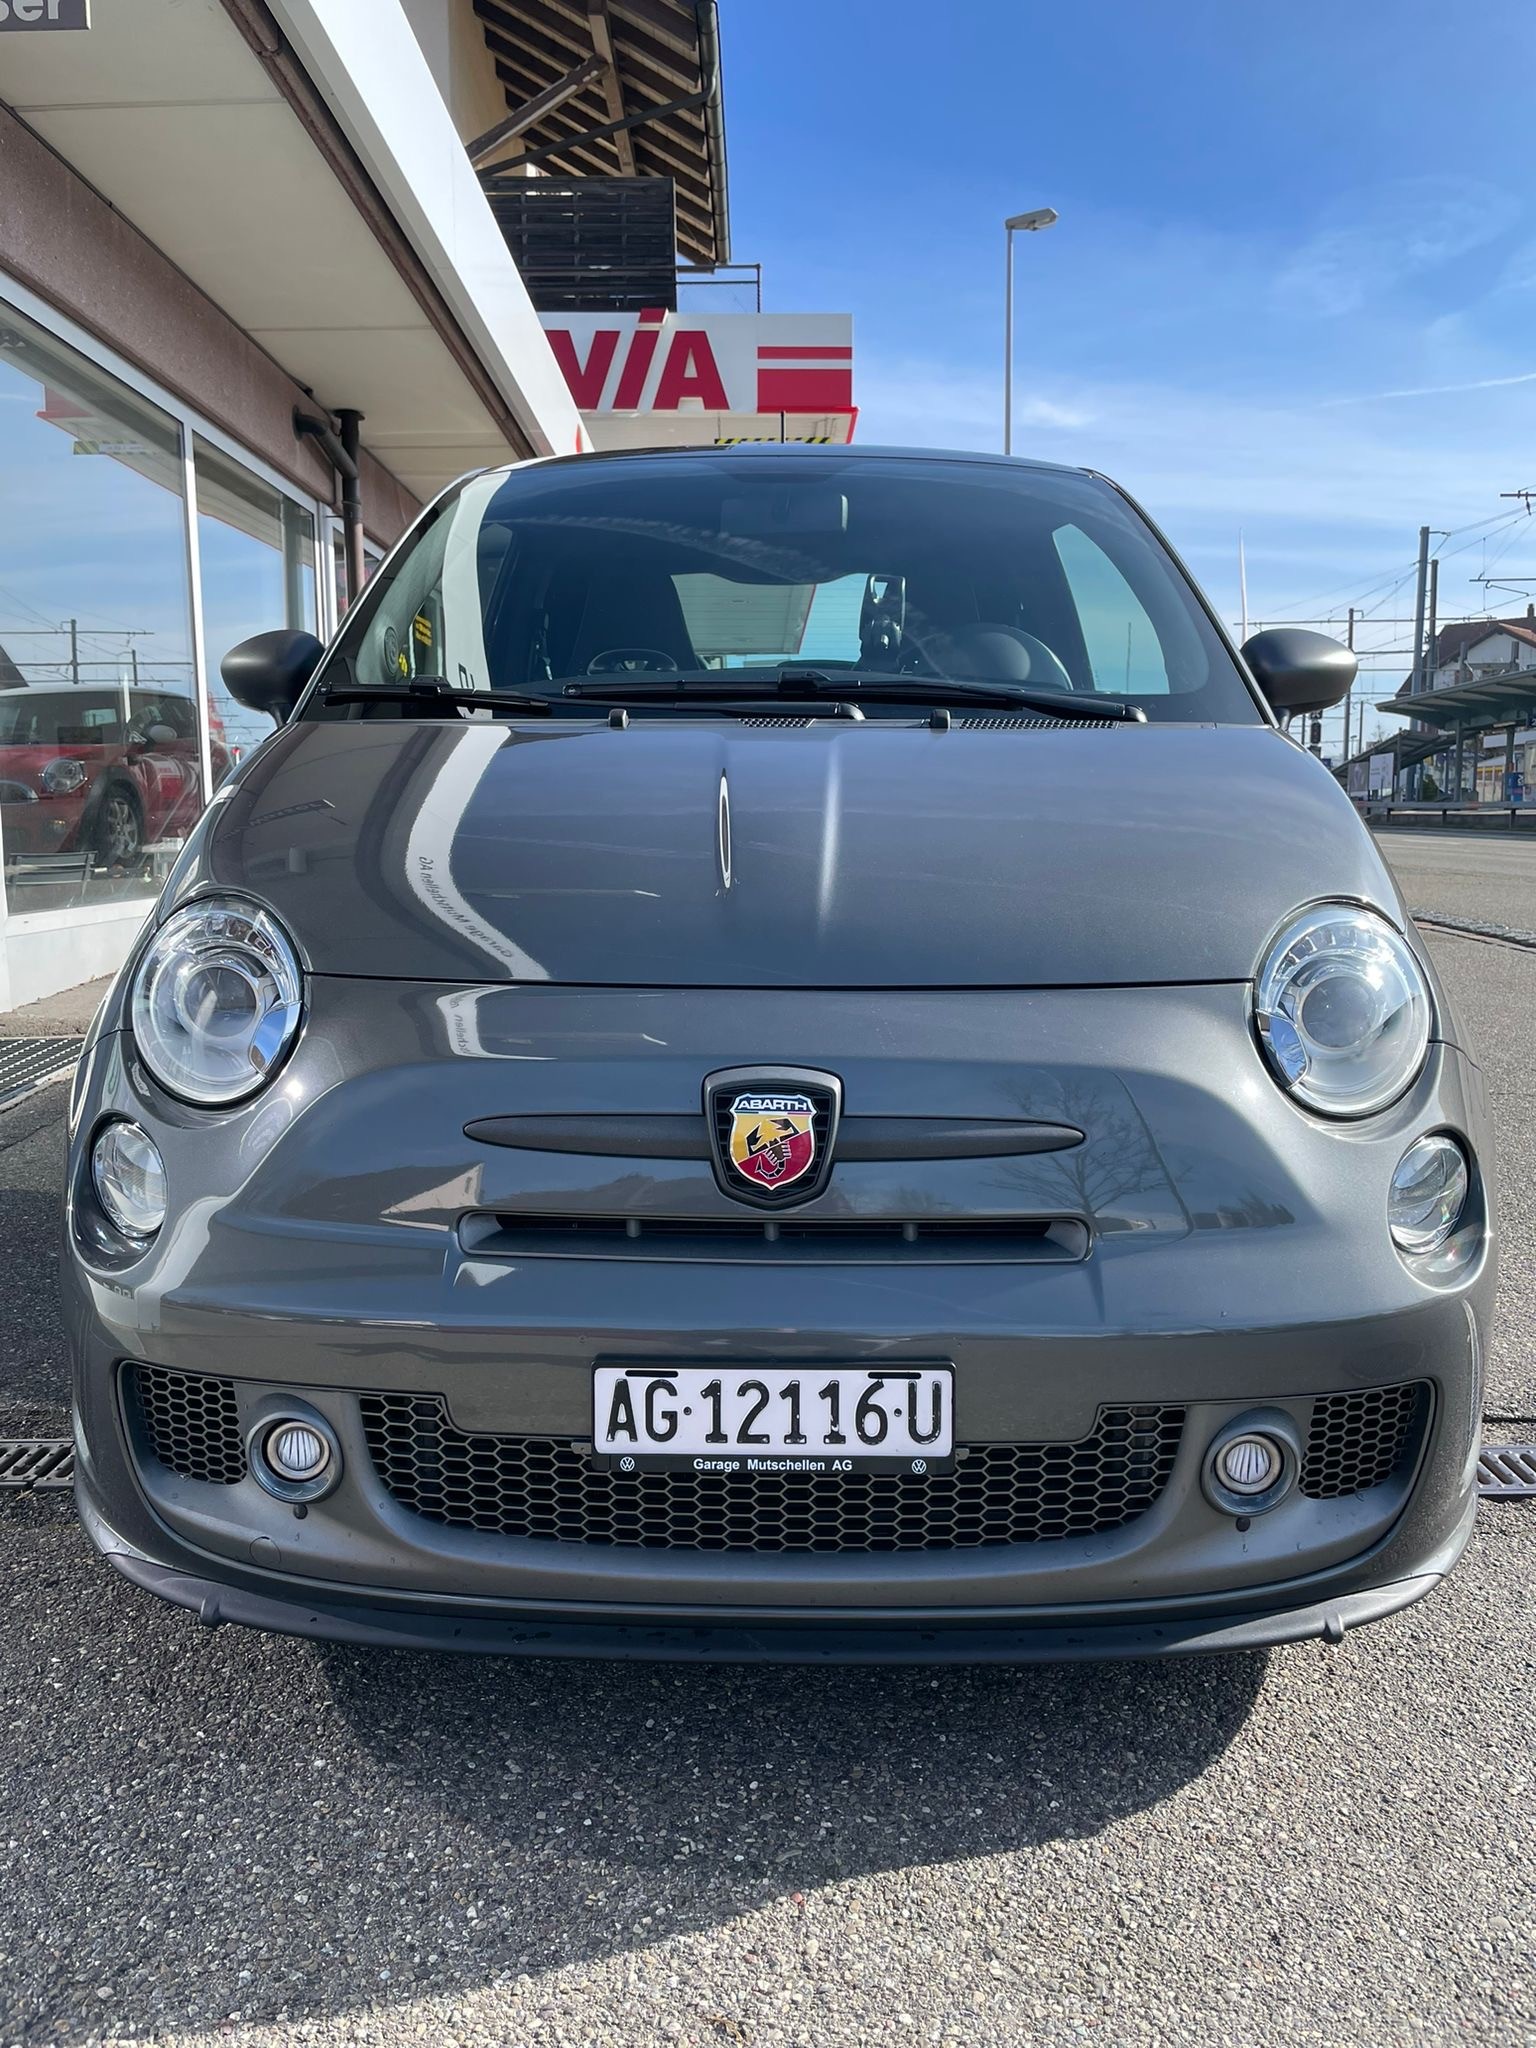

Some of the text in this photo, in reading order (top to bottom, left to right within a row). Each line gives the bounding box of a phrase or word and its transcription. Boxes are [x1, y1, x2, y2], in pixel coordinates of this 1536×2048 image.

[738, 1099, 807, 1111] ABARTH
[693, 1458, 853, 1472] Garage Mutschellen AG
